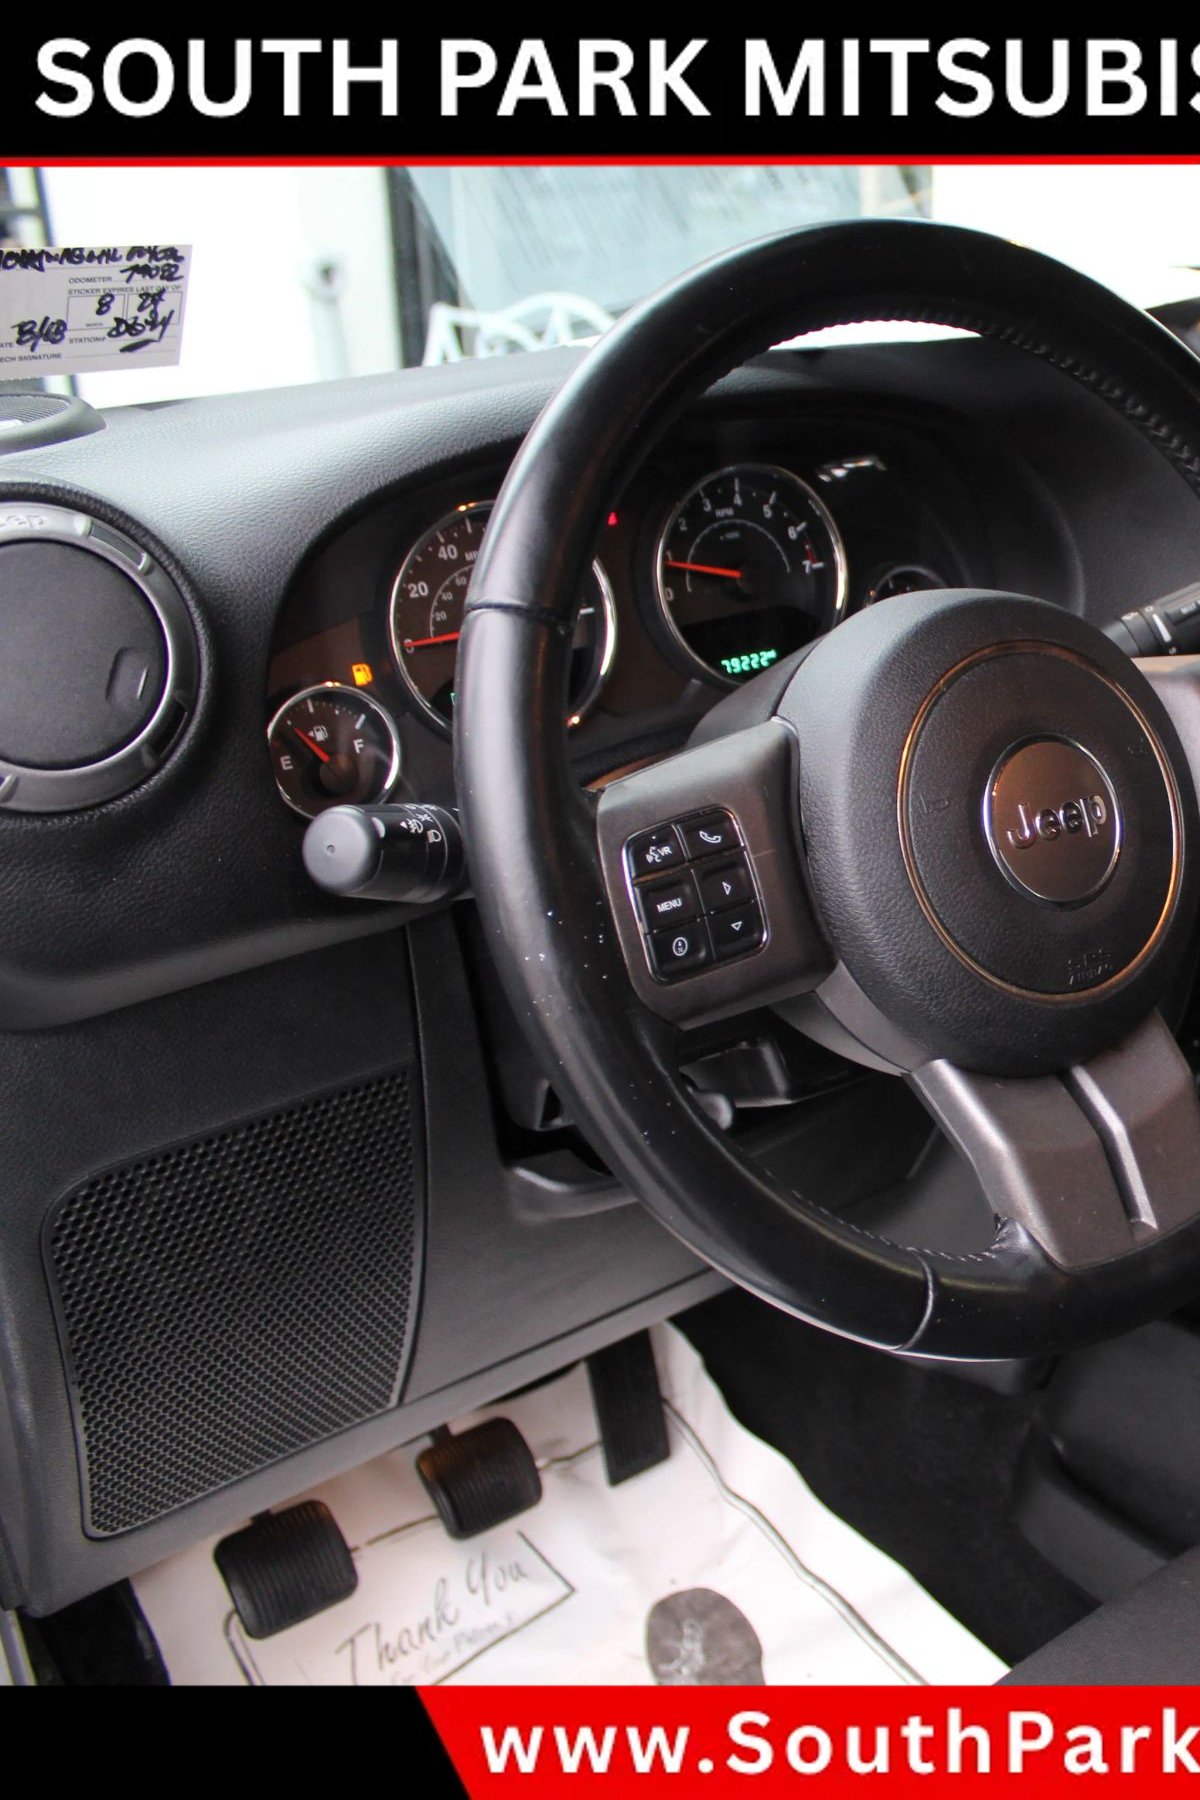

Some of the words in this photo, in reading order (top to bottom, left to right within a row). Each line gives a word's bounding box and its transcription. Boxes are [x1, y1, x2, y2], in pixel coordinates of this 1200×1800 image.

[68, 276, 113, 284] ODOMETER
[67, 287, 101, 295] STICKER
[136, 284, 154, 292] LAST
[18, 353, 62, 362] SIGNATURE
[702, 498, 712, 512] 3
[762, 504, 773, 519] 5
[715, 507, 734, 518] RPM
[678, 517, 688, 531] 2
[787, 526, 798, 540] 6
[438, 544, 458, 560] 40
[801, 560, 811, 574] 7
[407, 581, 429, 598] 20
[664, 587, 674, 601] 0
[353, 738, 364, 754] F
[280, 755, 293, 771] E
[1007, 796, 1106, 849] Jeep
[658, 846, 672, 856] VR
[656, 898, 683, 913] MENU
